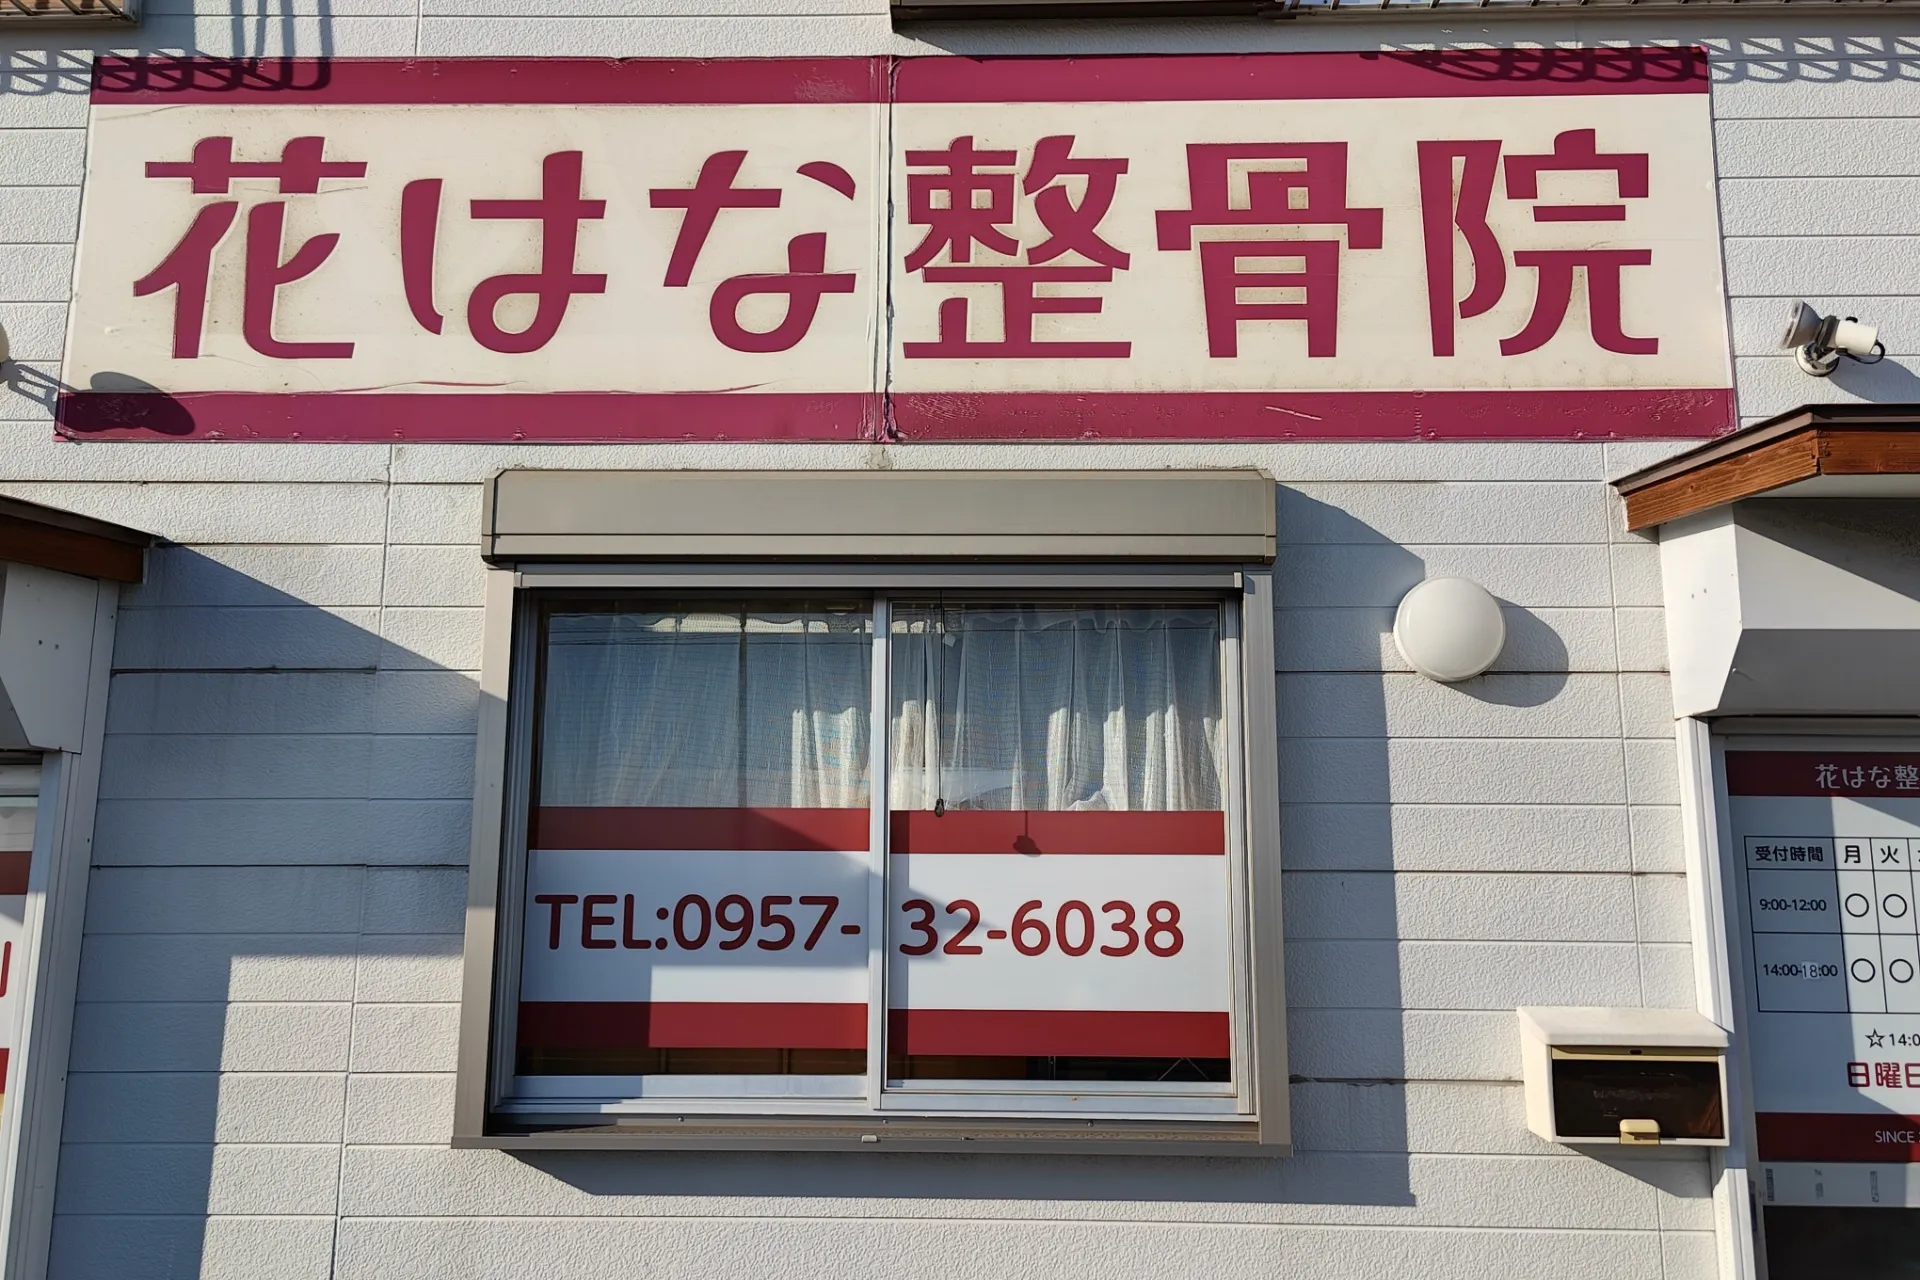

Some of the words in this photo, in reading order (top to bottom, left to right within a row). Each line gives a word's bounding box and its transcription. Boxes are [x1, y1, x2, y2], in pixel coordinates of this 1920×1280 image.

[133, 128, 1659, 359] 花はな整骨院
[1755, 845, 1824, 862] 受付時間
[1844, 844, 1862, 864] 月
[1880, 845, 1900, 864] 火
[1759, 898, 1827, 912] 9:00-12:00
[1763, 963, 1838, 978] 14:00-18:00
[1874, 1130, 1915, 1144] SINCE
